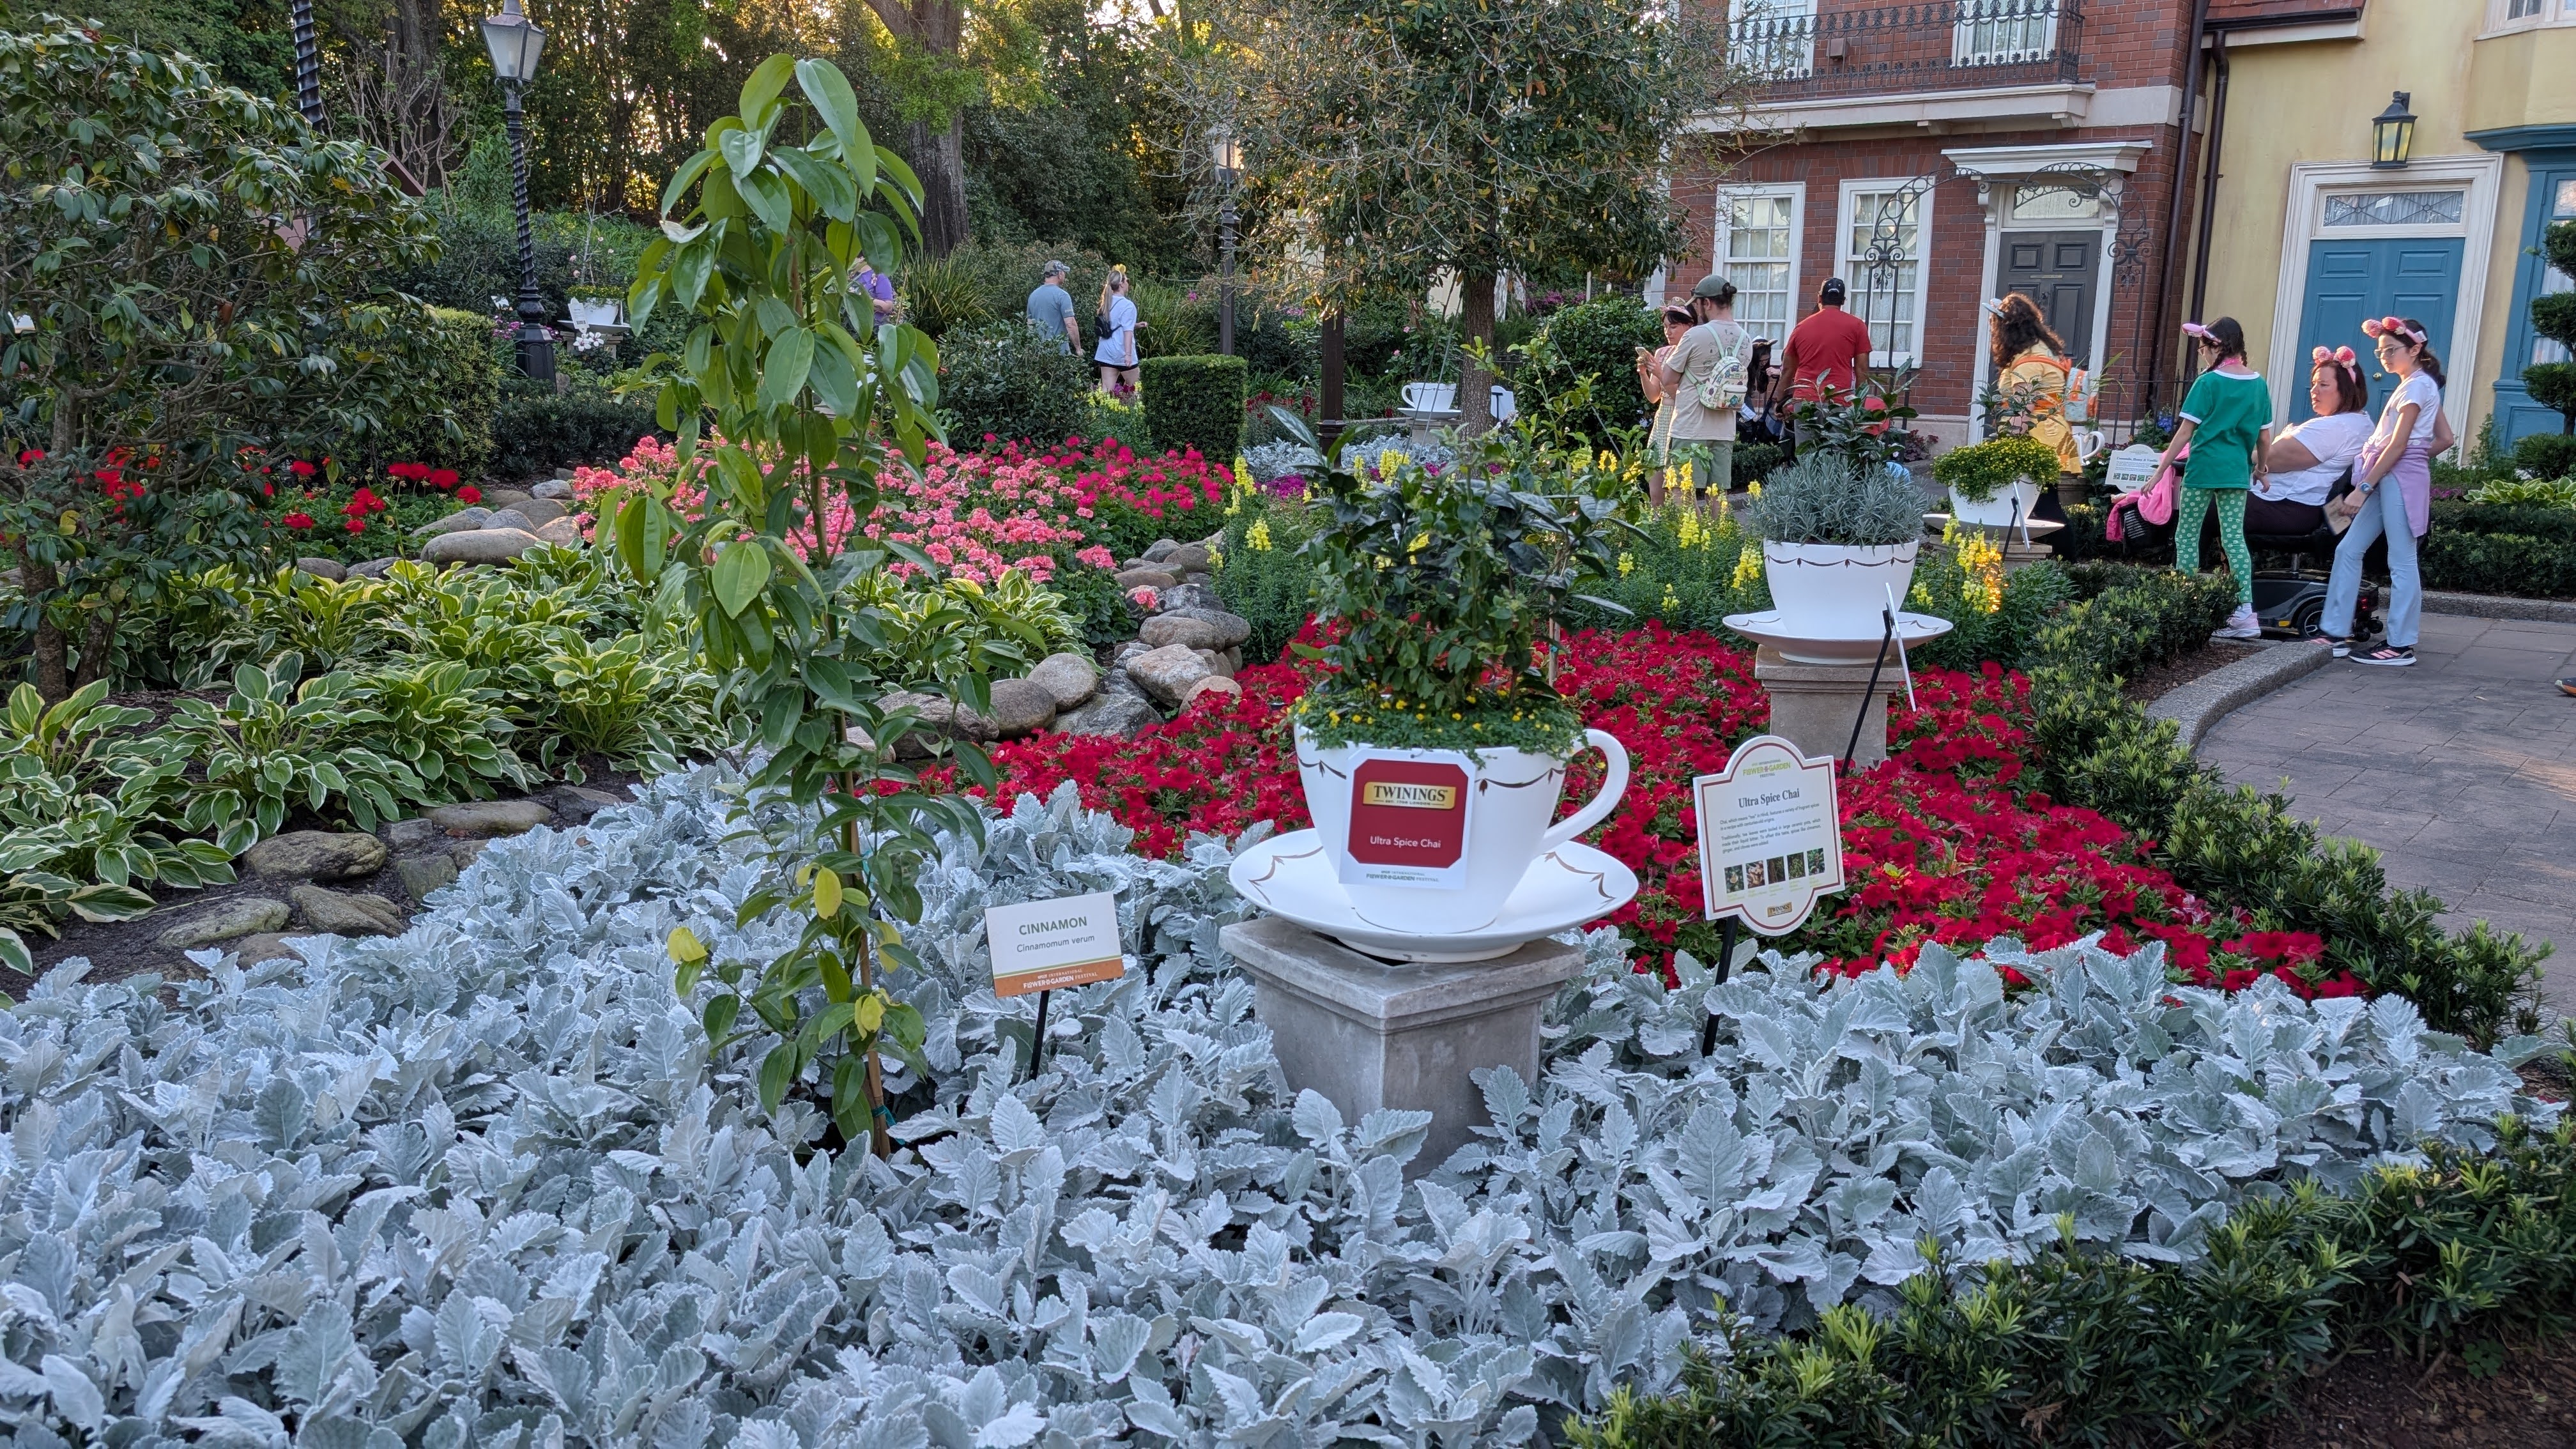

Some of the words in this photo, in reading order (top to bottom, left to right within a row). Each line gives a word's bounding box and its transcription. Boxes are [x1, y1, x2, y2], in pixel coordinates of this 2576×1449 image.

[1374, 785, 1446, 802] TWININGS
[1738, 797, 1759, 808] Ultra
[1760, 793, 1781, 806] Spice
[1782, 788, 1800, 800] Chai
[1370, 836, 1392, 845] Ultra
[1393, 837, 1418, 848] Spice
[1420, 838, 1441, 848] Chai
[1019, 916, 1087, 935] CINNAMON
[1016, 939, 1070, 953] Cinnamomum
[1071, 935, 1095, 944] verum
[1023, 979, 1046, 989] FLOWER
[1050, 975, 1075, 985] GARDEN
[1075, 972, 1098, 980] FESTIVAL
